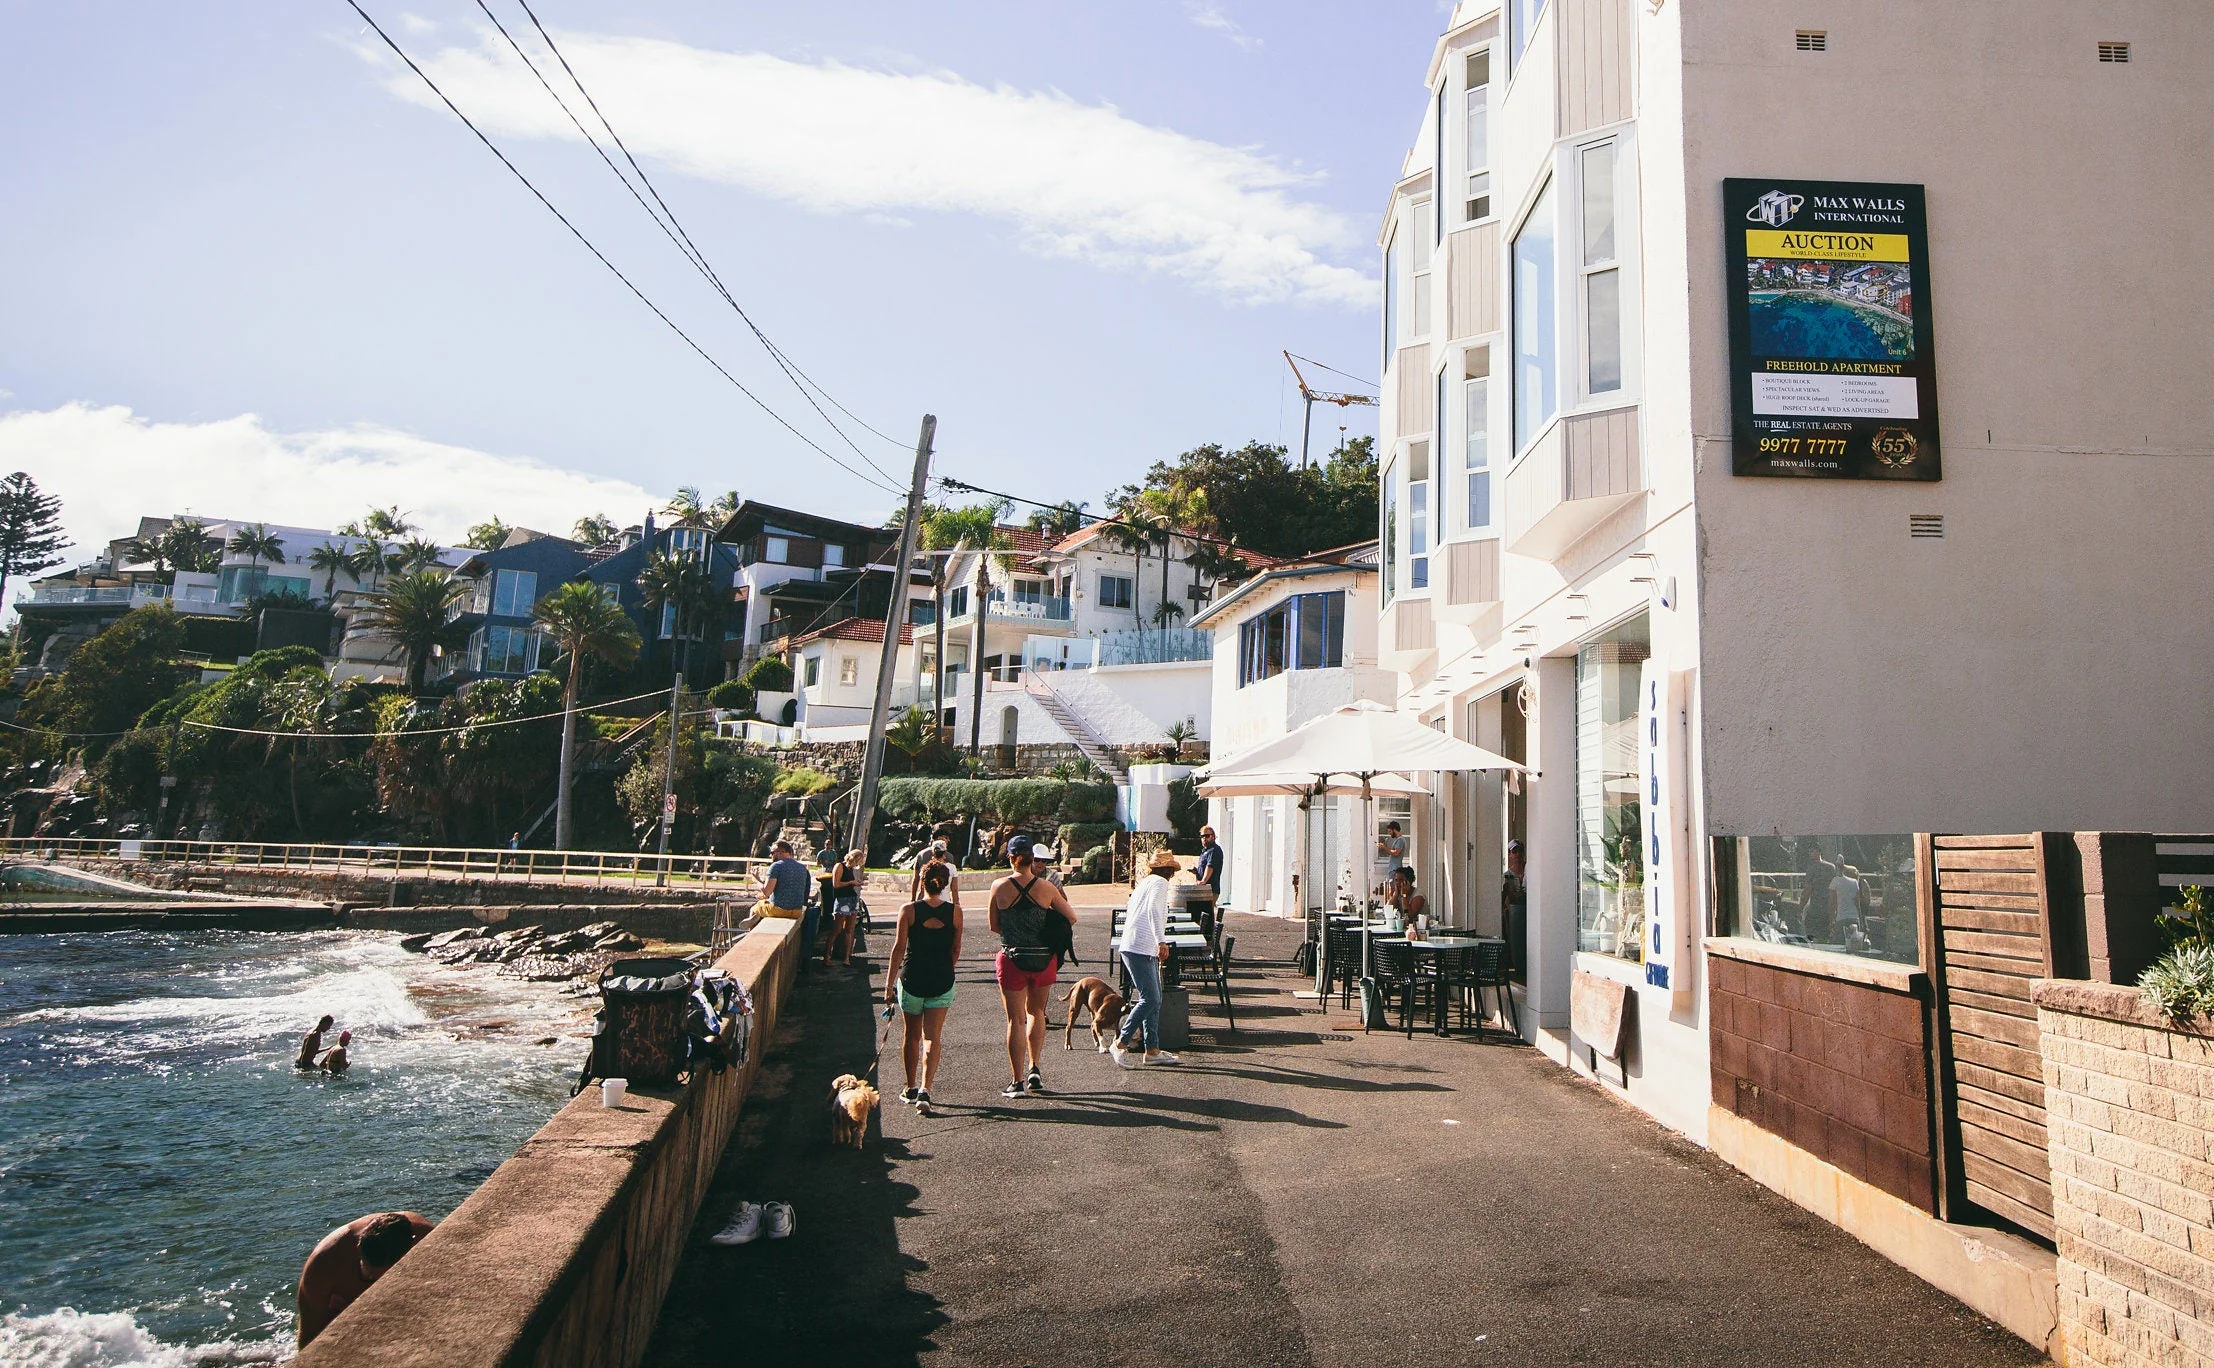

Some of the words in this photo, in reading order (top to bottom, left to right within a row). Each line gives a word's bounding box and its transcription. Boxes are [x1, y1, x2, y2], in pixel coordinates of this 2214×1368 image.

[1814, 197, 1848, 209] MAX
[1853, 198, 1905, 211] WALLS
[1814, 213, 1904, 223] INTERNATIONAL
[1782, 234, 1874, 251] AUCTION
[1766, 361, 1828, 372] FREEHOLD
[1832, 363, 1901, 374] APARTMENT
[1754, 420, 1769, 428] THE
[1771, 421, 1791, 429] REAL
[1793, 422, 1821, 430] ESTATE
[1823, 422, 1852, 430] AGENTS
[1760, 438, 1801, 453] 9977
[1807, 438, 1846, 455] 7777
[1882, 438, 1905, 452] 55
[1771, 460, 1838, 468] maxwalls.com
